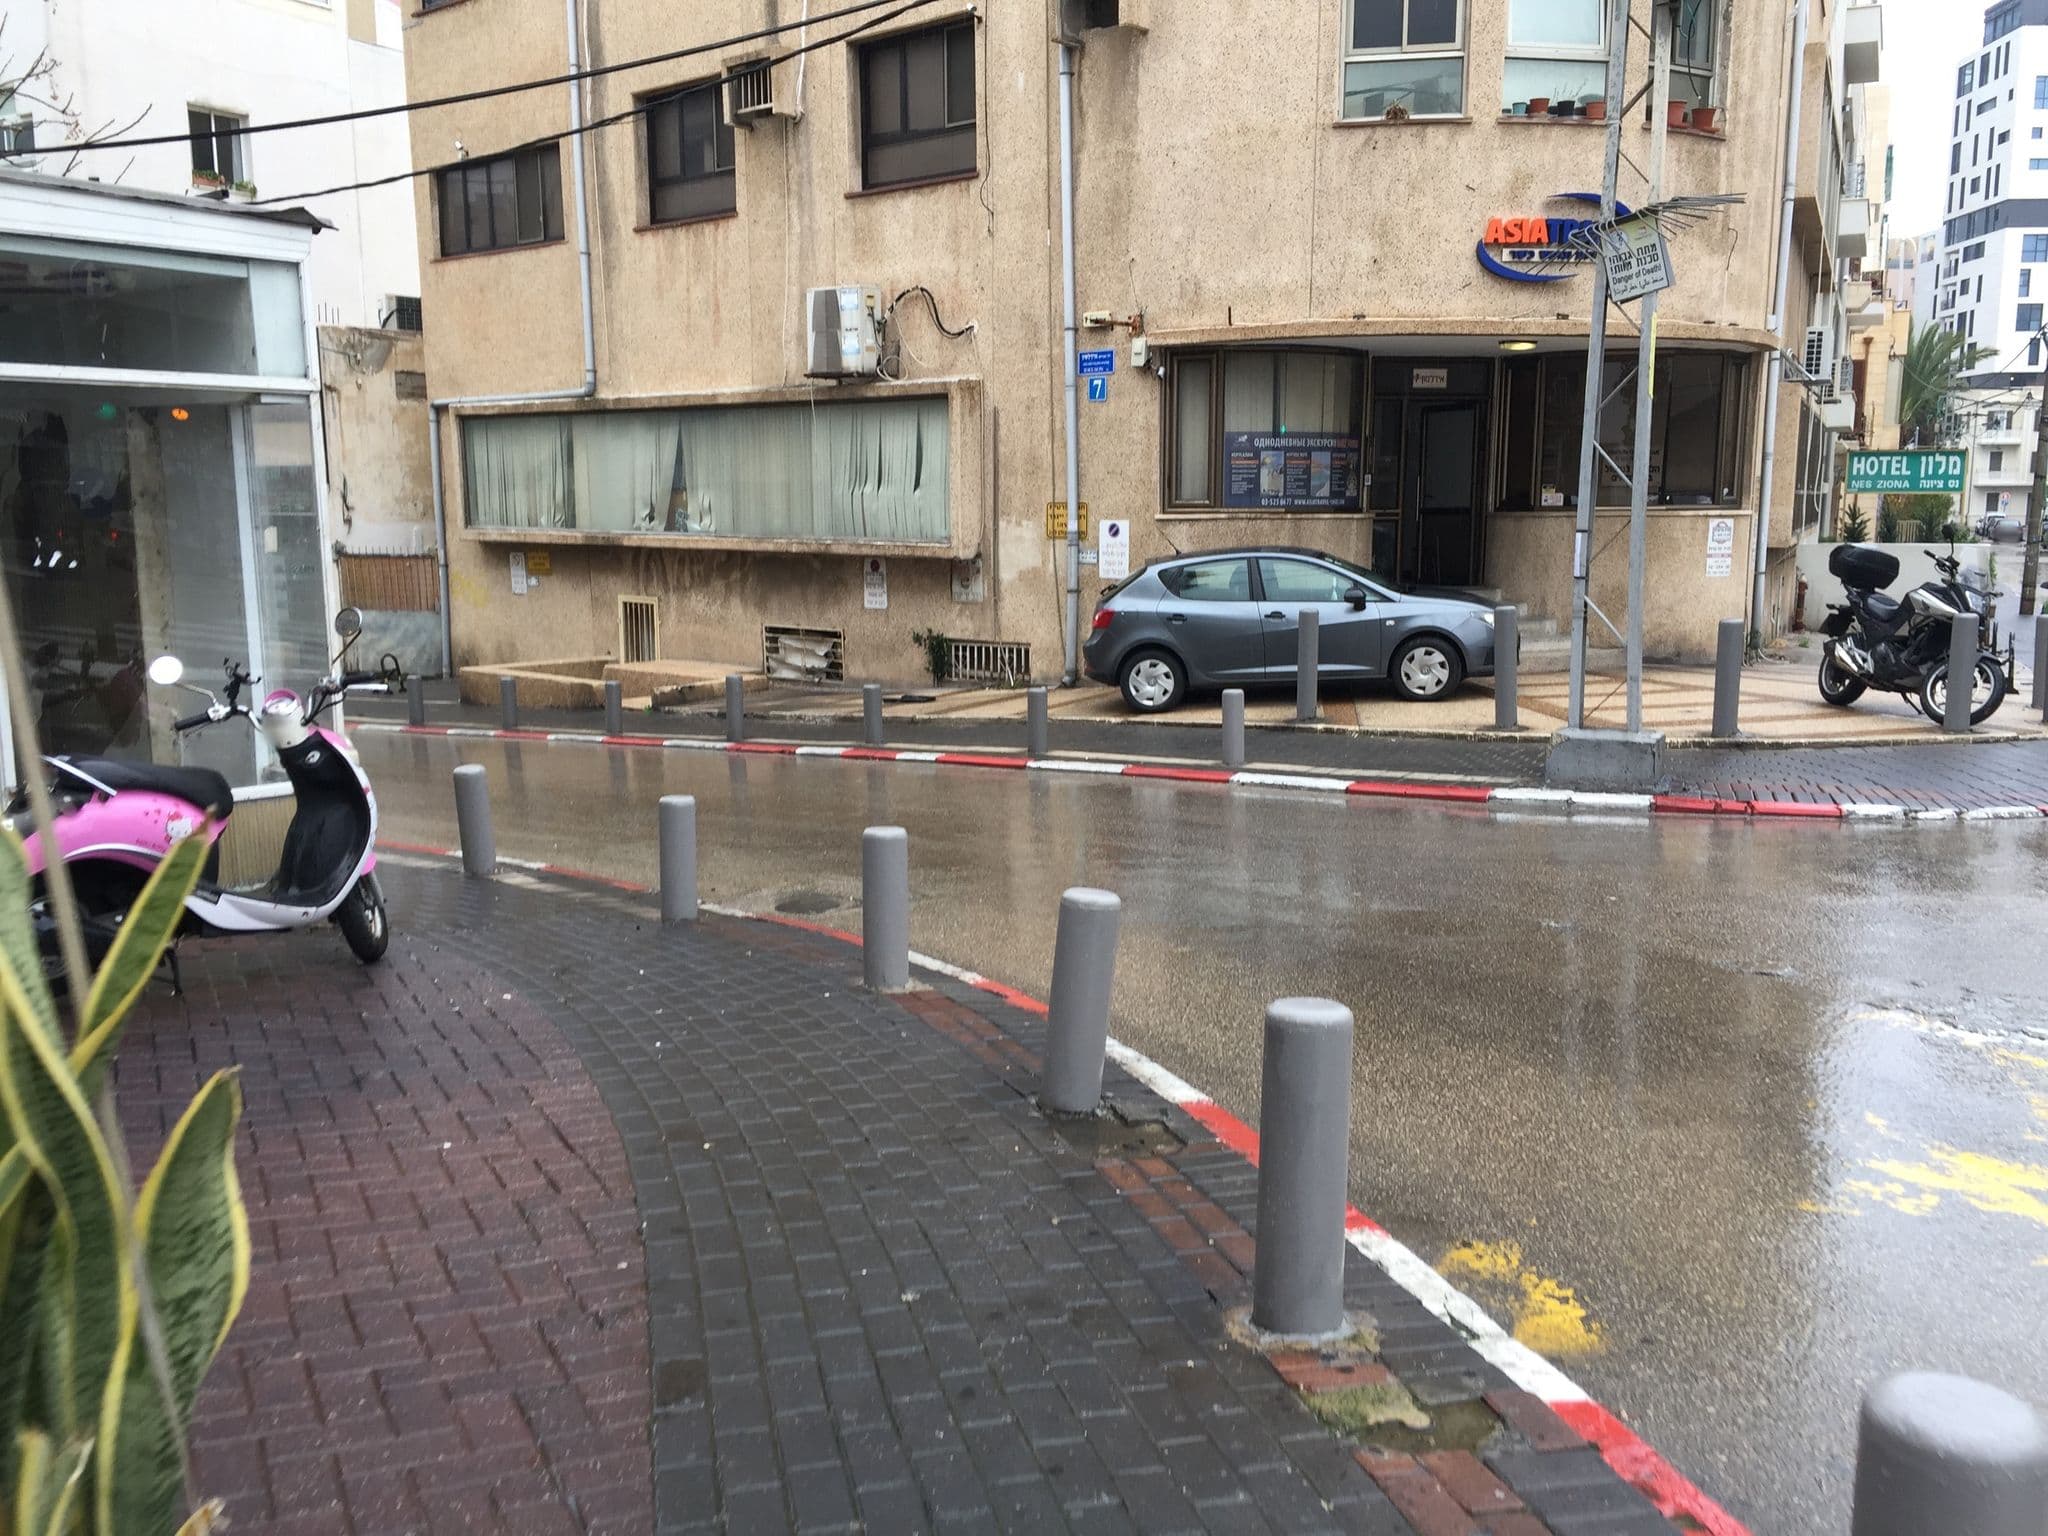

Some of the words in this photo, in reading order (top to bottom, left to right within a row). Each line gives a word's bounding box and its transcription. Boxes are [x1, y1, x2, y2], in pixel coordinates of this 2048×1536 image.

[1613, 273, 1633, 285] Danger
[1635, 269, 1641, 279] of
[1093, 379, 1102, 399] 7
[1254, 438, 1306, 448] ОДНОДНЕВНЫЕ
[1852, 456, 1911, 476] HOTEL
[1920, 453, 1961, 478] מלון
[1851, 480, 1872, 488] NES
[1876, 480, 1910, 488] ZIONA
[1919, 480, 1944, 488] ציונה
[1948, 480, 1960, 489] נס
